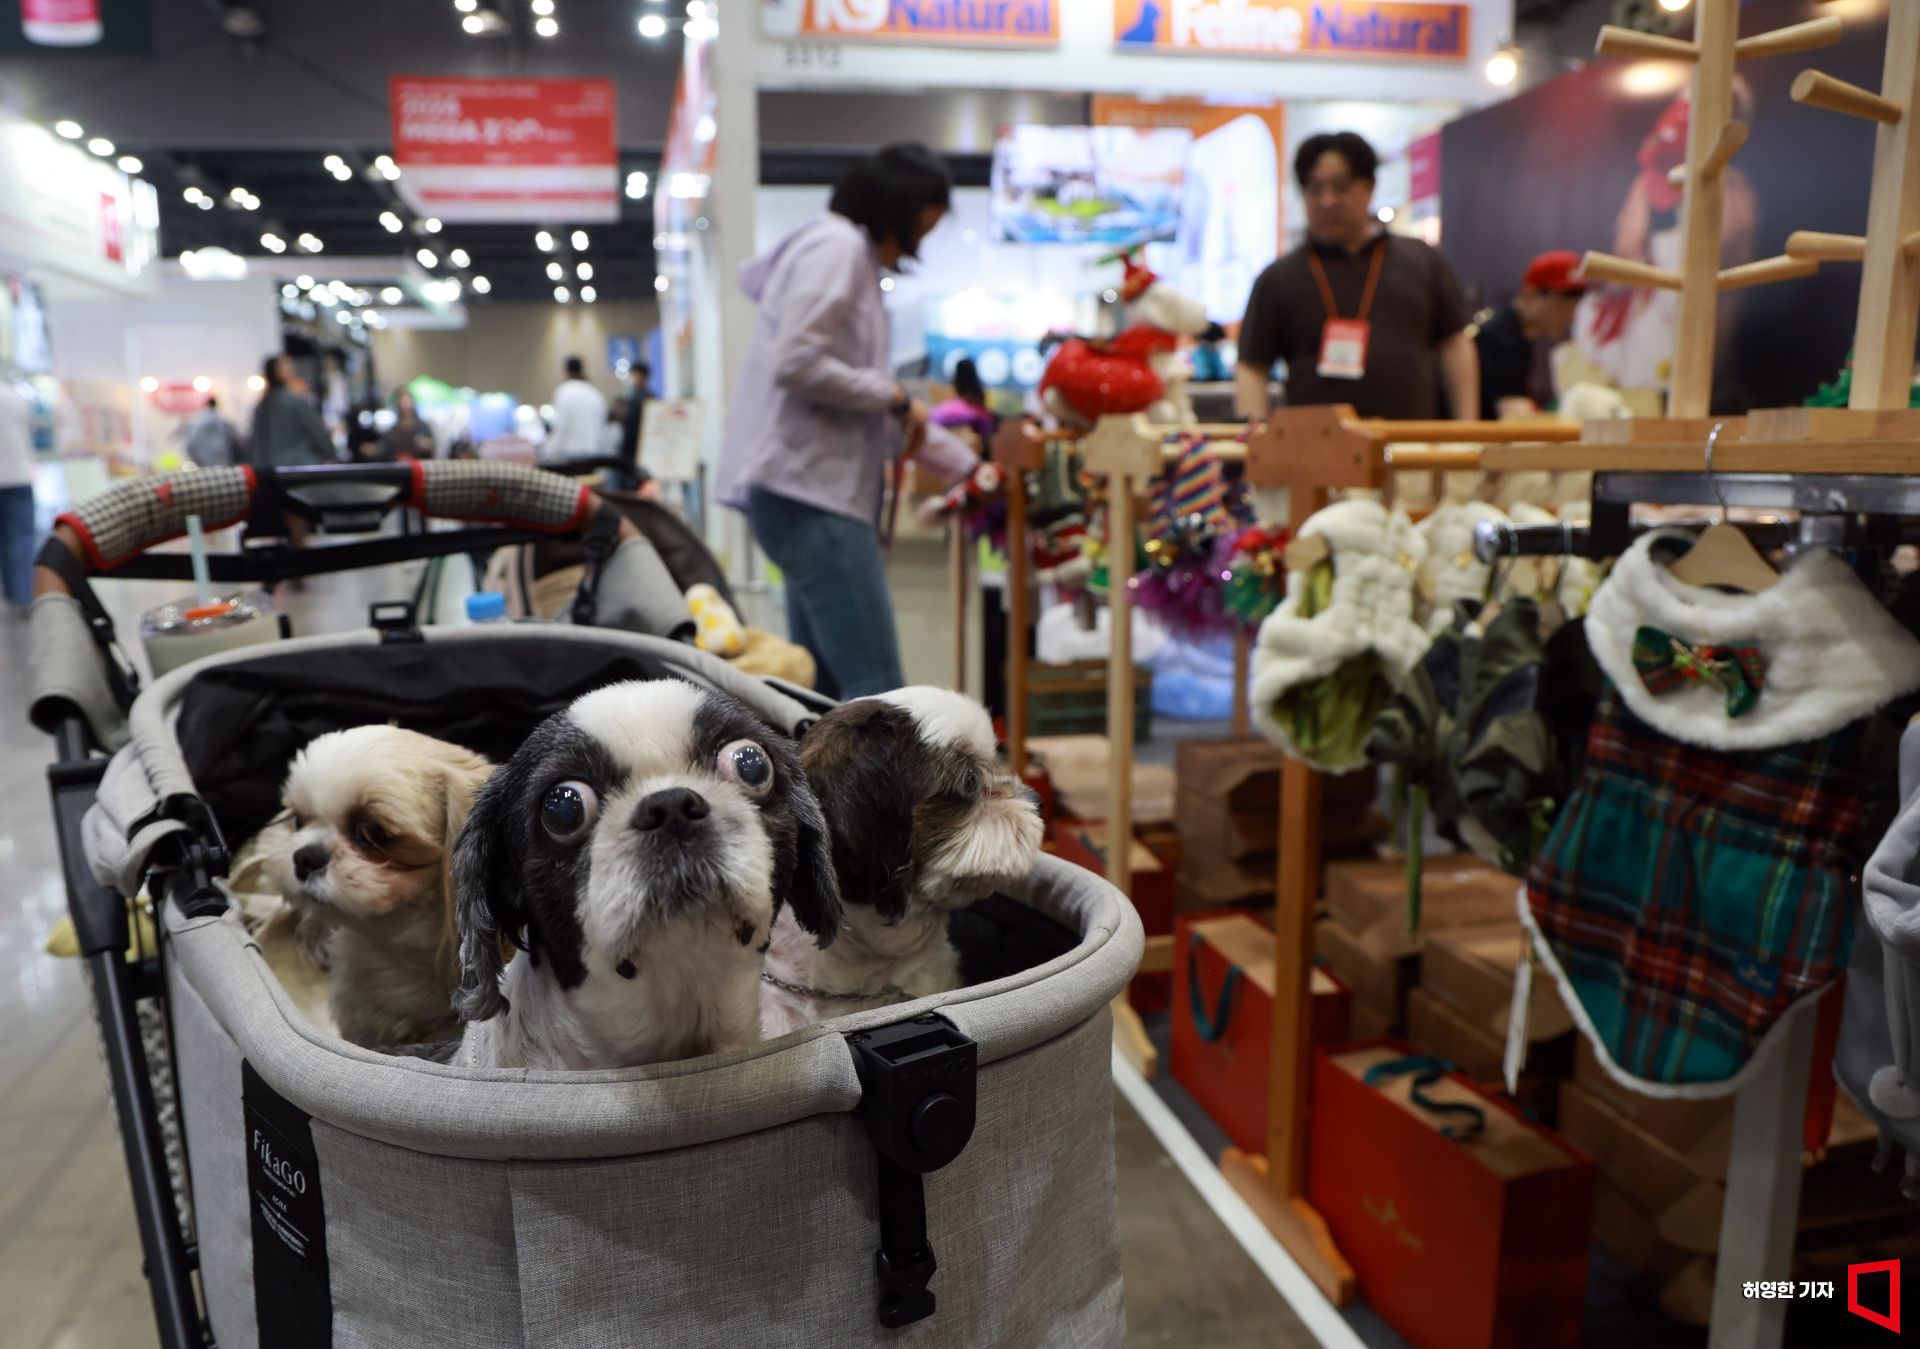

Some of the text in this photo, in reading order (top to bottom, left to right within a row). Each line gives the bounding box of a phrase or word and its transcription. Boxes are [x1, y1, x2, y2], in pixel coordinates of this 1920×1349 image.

[889, 0, 1050, 33] Natural
[1171, 0, 1462, 56] Feline Natural
[253, 1129, 306, 1194] FikaGO
